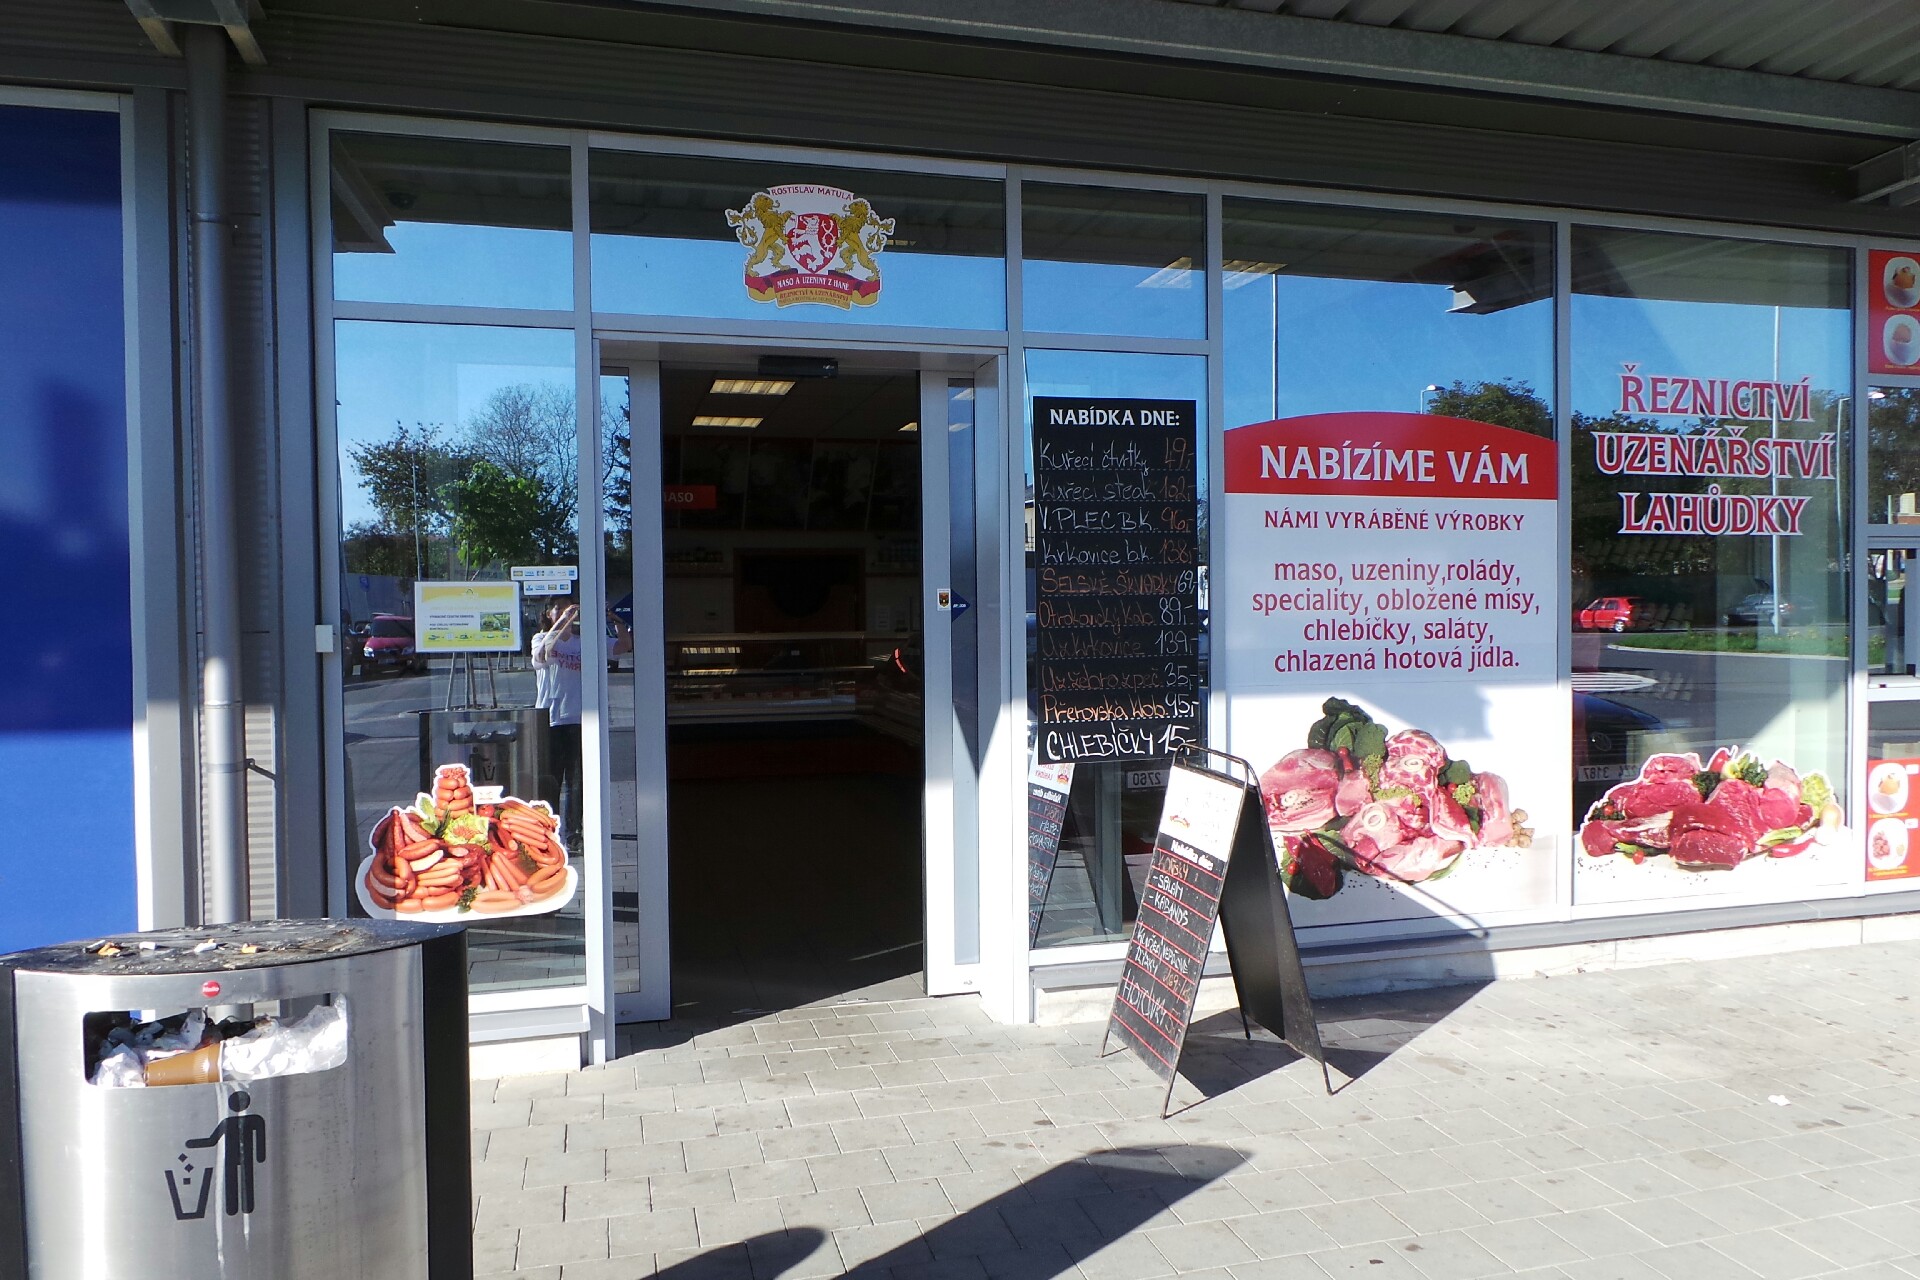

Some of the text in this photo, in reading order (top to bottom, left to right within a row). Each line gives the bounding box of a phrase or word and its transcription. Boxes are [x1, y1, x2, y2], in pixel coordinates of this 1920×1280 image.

[771, 186, 852, 201] ROSTISLAV MATULA
[777, 278, 794, 288] MASO
[795, 277, 800, 285] A
[802, 276, 827, 285] UZENINY
[828, 278, 833, 286] Z
[1616, 362, 1815, 422] ŘEZNICTVÍ
[1050, 405, 1180, 426] NABÍDKA DNE:
[1260, 440, 1529, 484] NABÍZÍME VÁM
[1591, 425, 1836, 480] UZENÁŘSTVÍ
[1264, 507, 1525, 531] NÁMI VYRÁBĚNÉ VÝROBKY
[1617, 484, 1813, 536] LAHŮDKY
[1274, 562, 1344, 585] maso,
[1252, 587, 1540, 615] speciality, obložené mísy,
[1303, 616, 1494, 645] chlebíčky, saláty,
[1273, 646, 1520, 672] chlazená hotová jídla.
